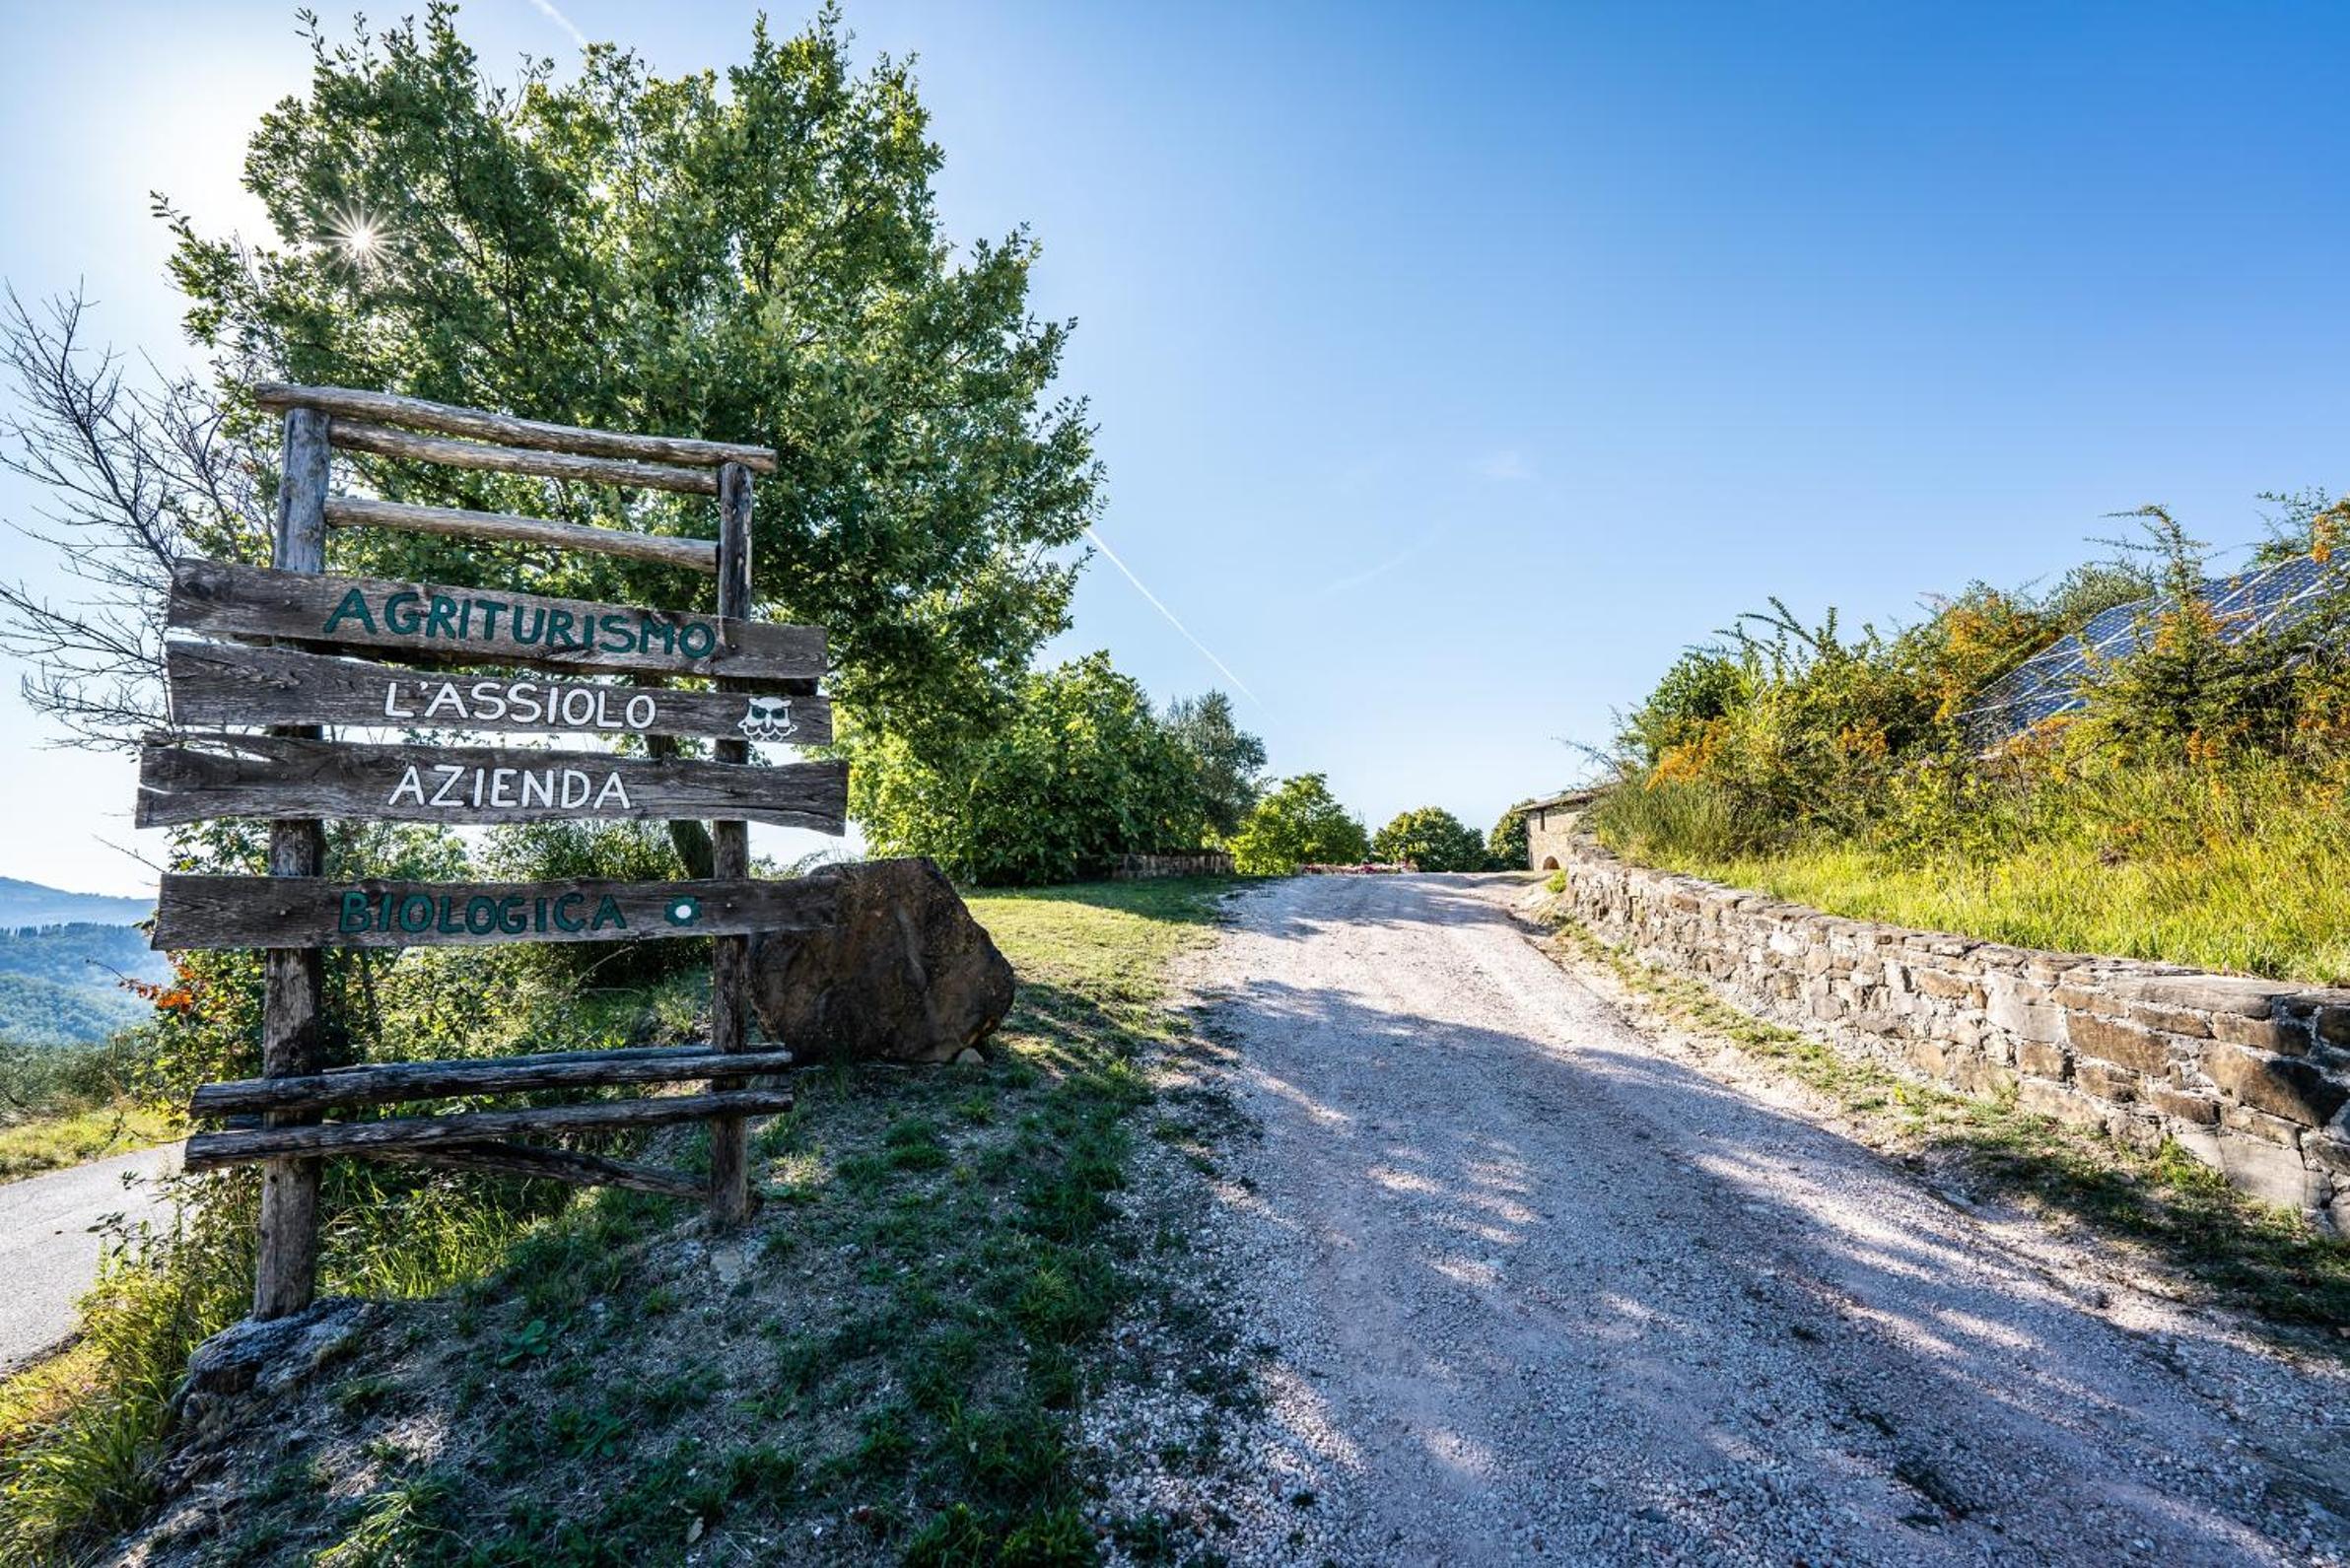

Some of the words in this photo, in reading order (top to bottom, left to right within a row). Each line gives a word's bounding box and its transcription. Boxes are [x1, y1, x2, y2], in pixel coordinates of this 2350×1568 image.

[323, 587, 717, 659] AGRITURISMO
[383, 681, 657, 730] L'ASSIOLO
[387, 765, 632, 810] AZIENDA
[338, 890, 628, 934] BIOLOGICA
